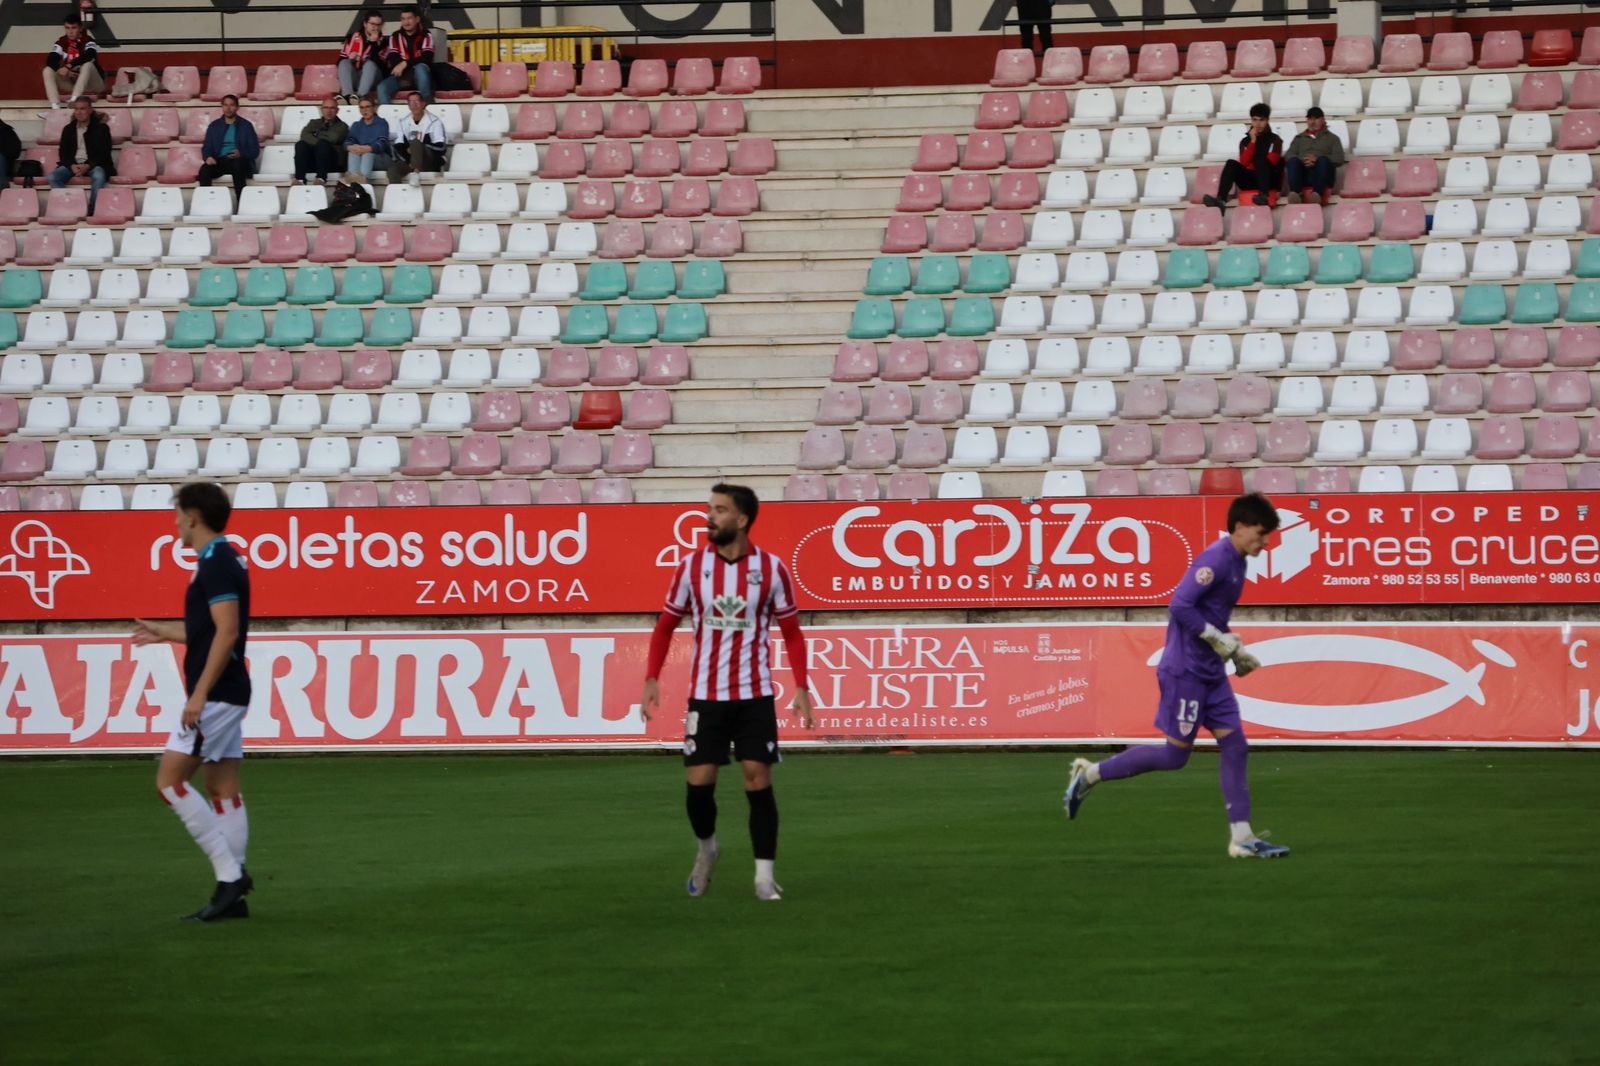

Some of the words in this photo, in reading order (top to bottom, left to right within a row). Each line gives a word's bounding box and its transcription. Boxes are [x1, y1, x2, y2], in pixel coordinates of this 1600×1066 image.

[440, 511, 588, 568] salud
[1321, 531, 1433, 567] tres
[415, 578, 590, 604] ZAMORA
[832, 574, 990, 592] EMBUTIDOS
[1001, 575, 1014, 588] Y
[1023, 572, 1153, 589] JAMONES
[1322, 574, 1371, 586] Zamora
[1381, 573, 1405, 585] 980
[1407, 573, 1423, 585] 52
[1425, 573, 1441, 585] 53
[1443, 573, 1460, 585] 55
[1469, 573, 1537, 585] Benavente
[1549, 572, 1572, 584] 980
[1574, 572, 1591, 584] 63
[766, 635, 985, 671] ERNERA
[243, 637, 647, 740] RURAL
[1177, 698, 1200, 723] 13
